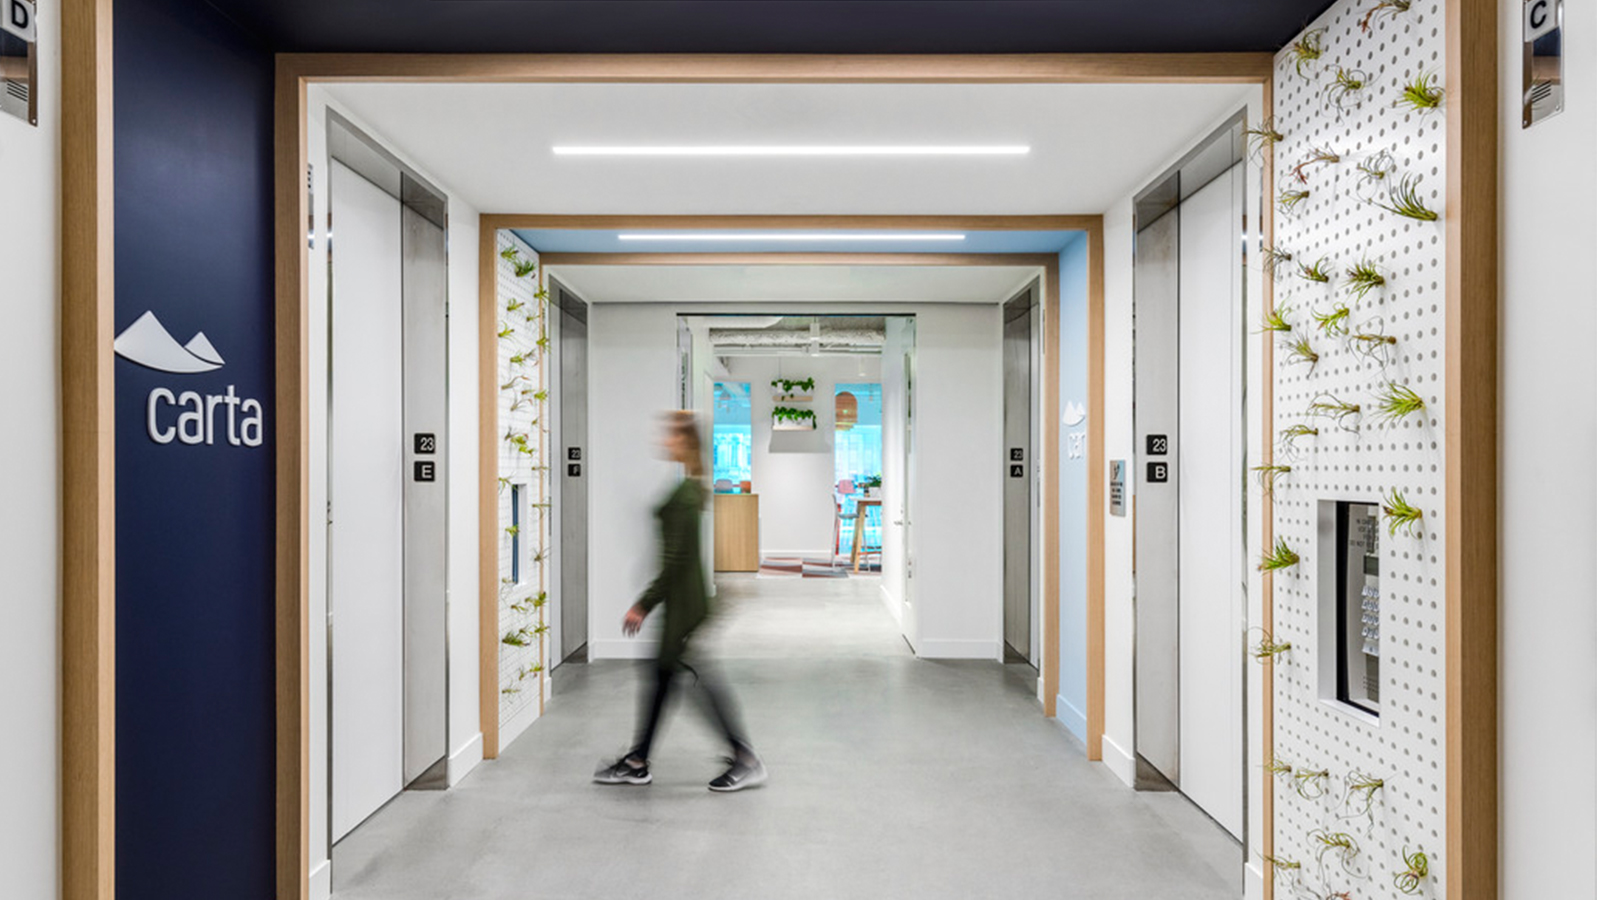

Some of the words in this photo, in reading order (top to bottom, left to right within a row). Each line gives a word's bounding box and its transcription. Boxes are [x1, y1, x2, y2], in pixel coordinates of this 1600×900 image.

[11, 0, 28, 28] D
[1530, 0, 1547, 29] C
[147, 384, 263, 447] carta
[420, 437, 434, 451] 23
[1152, 438, 1166, 452] 23
[422, 465, 432, 478] E
[1014, 466, 1021, 475] A
[1155, 466, 1166, 479] B
